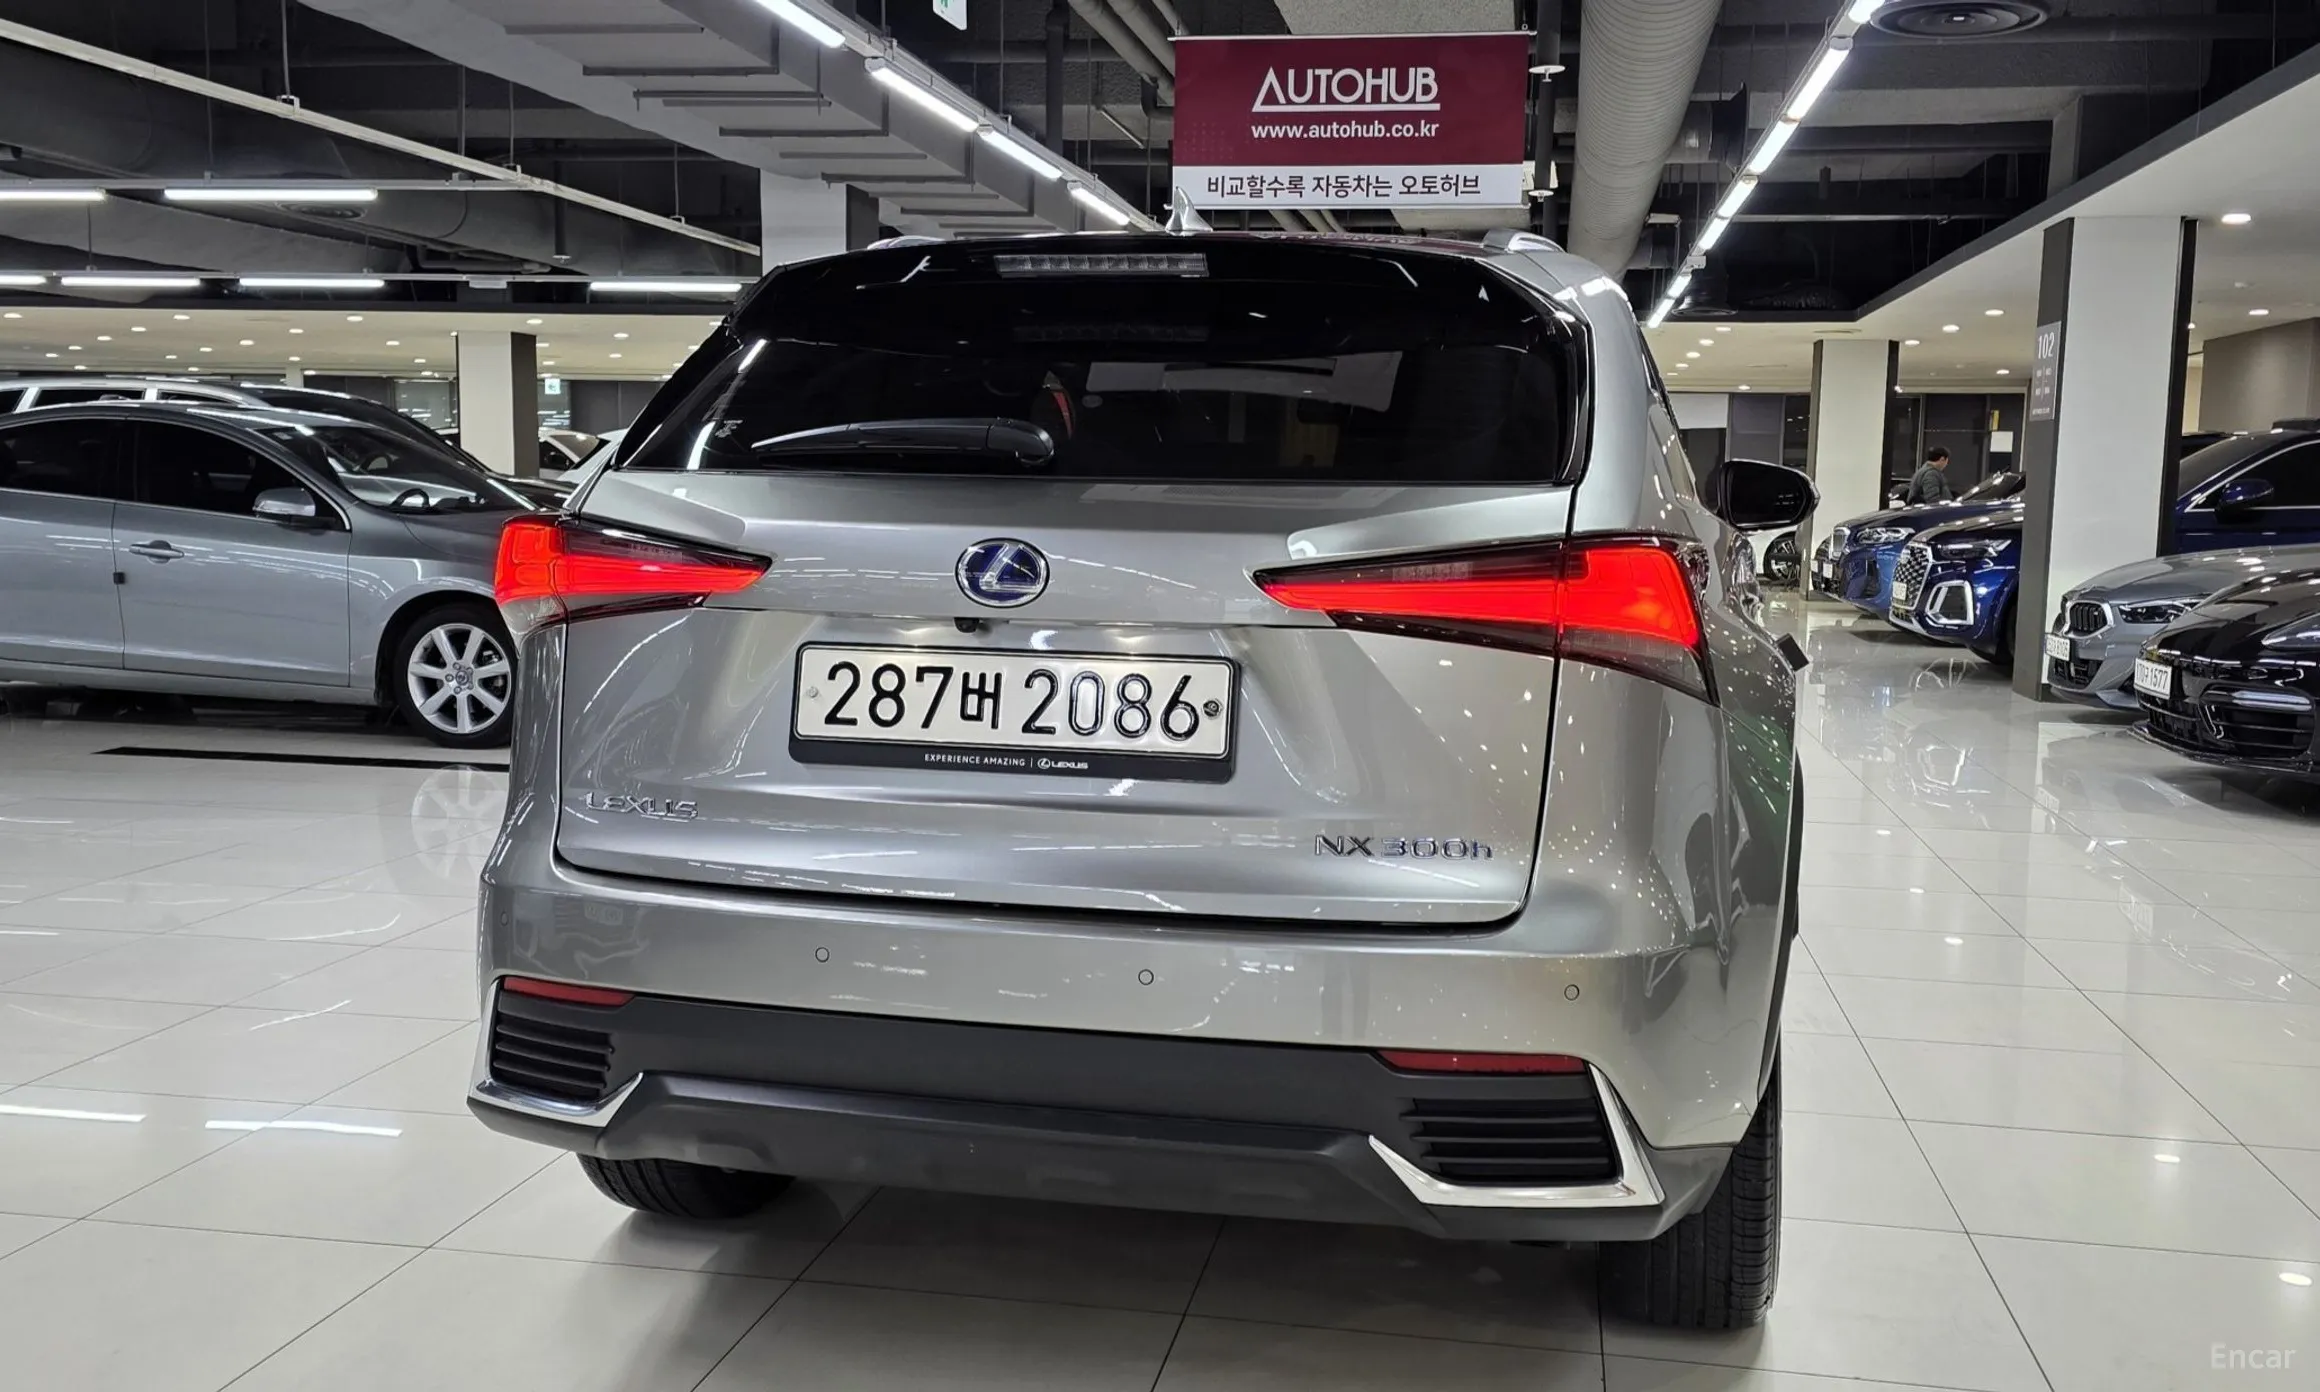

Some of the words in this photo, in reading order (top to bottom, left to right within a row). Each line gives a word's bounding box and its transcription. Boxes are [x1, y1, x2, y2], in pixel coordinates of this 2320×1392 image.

[1252, 66, 1441, 112] AUTOHUB
[1251, 119, 1440, 139] www.autohub.co.kr
[1207, 174, 1306, 198] 비교할수록
[1312, 174, 1393, 198] 자동차는
[1399, 174, 1481, 197] 오토허브
[2037, 331, 2056, 359] 102
[823, 660, 1003, 730] 287버
[1020, 667, 1201, 742] 2086
[924, 753, 981, 765] EXPERIENCE
[983, 756, 1026, 767] AMAZING
[1051, 761, 1089, 770] LEXUS
[584, 791, 699, 819] LEXUS
[1315, 834, 1376, 857] NX
[1380, 836, 1496, 860] 300h
